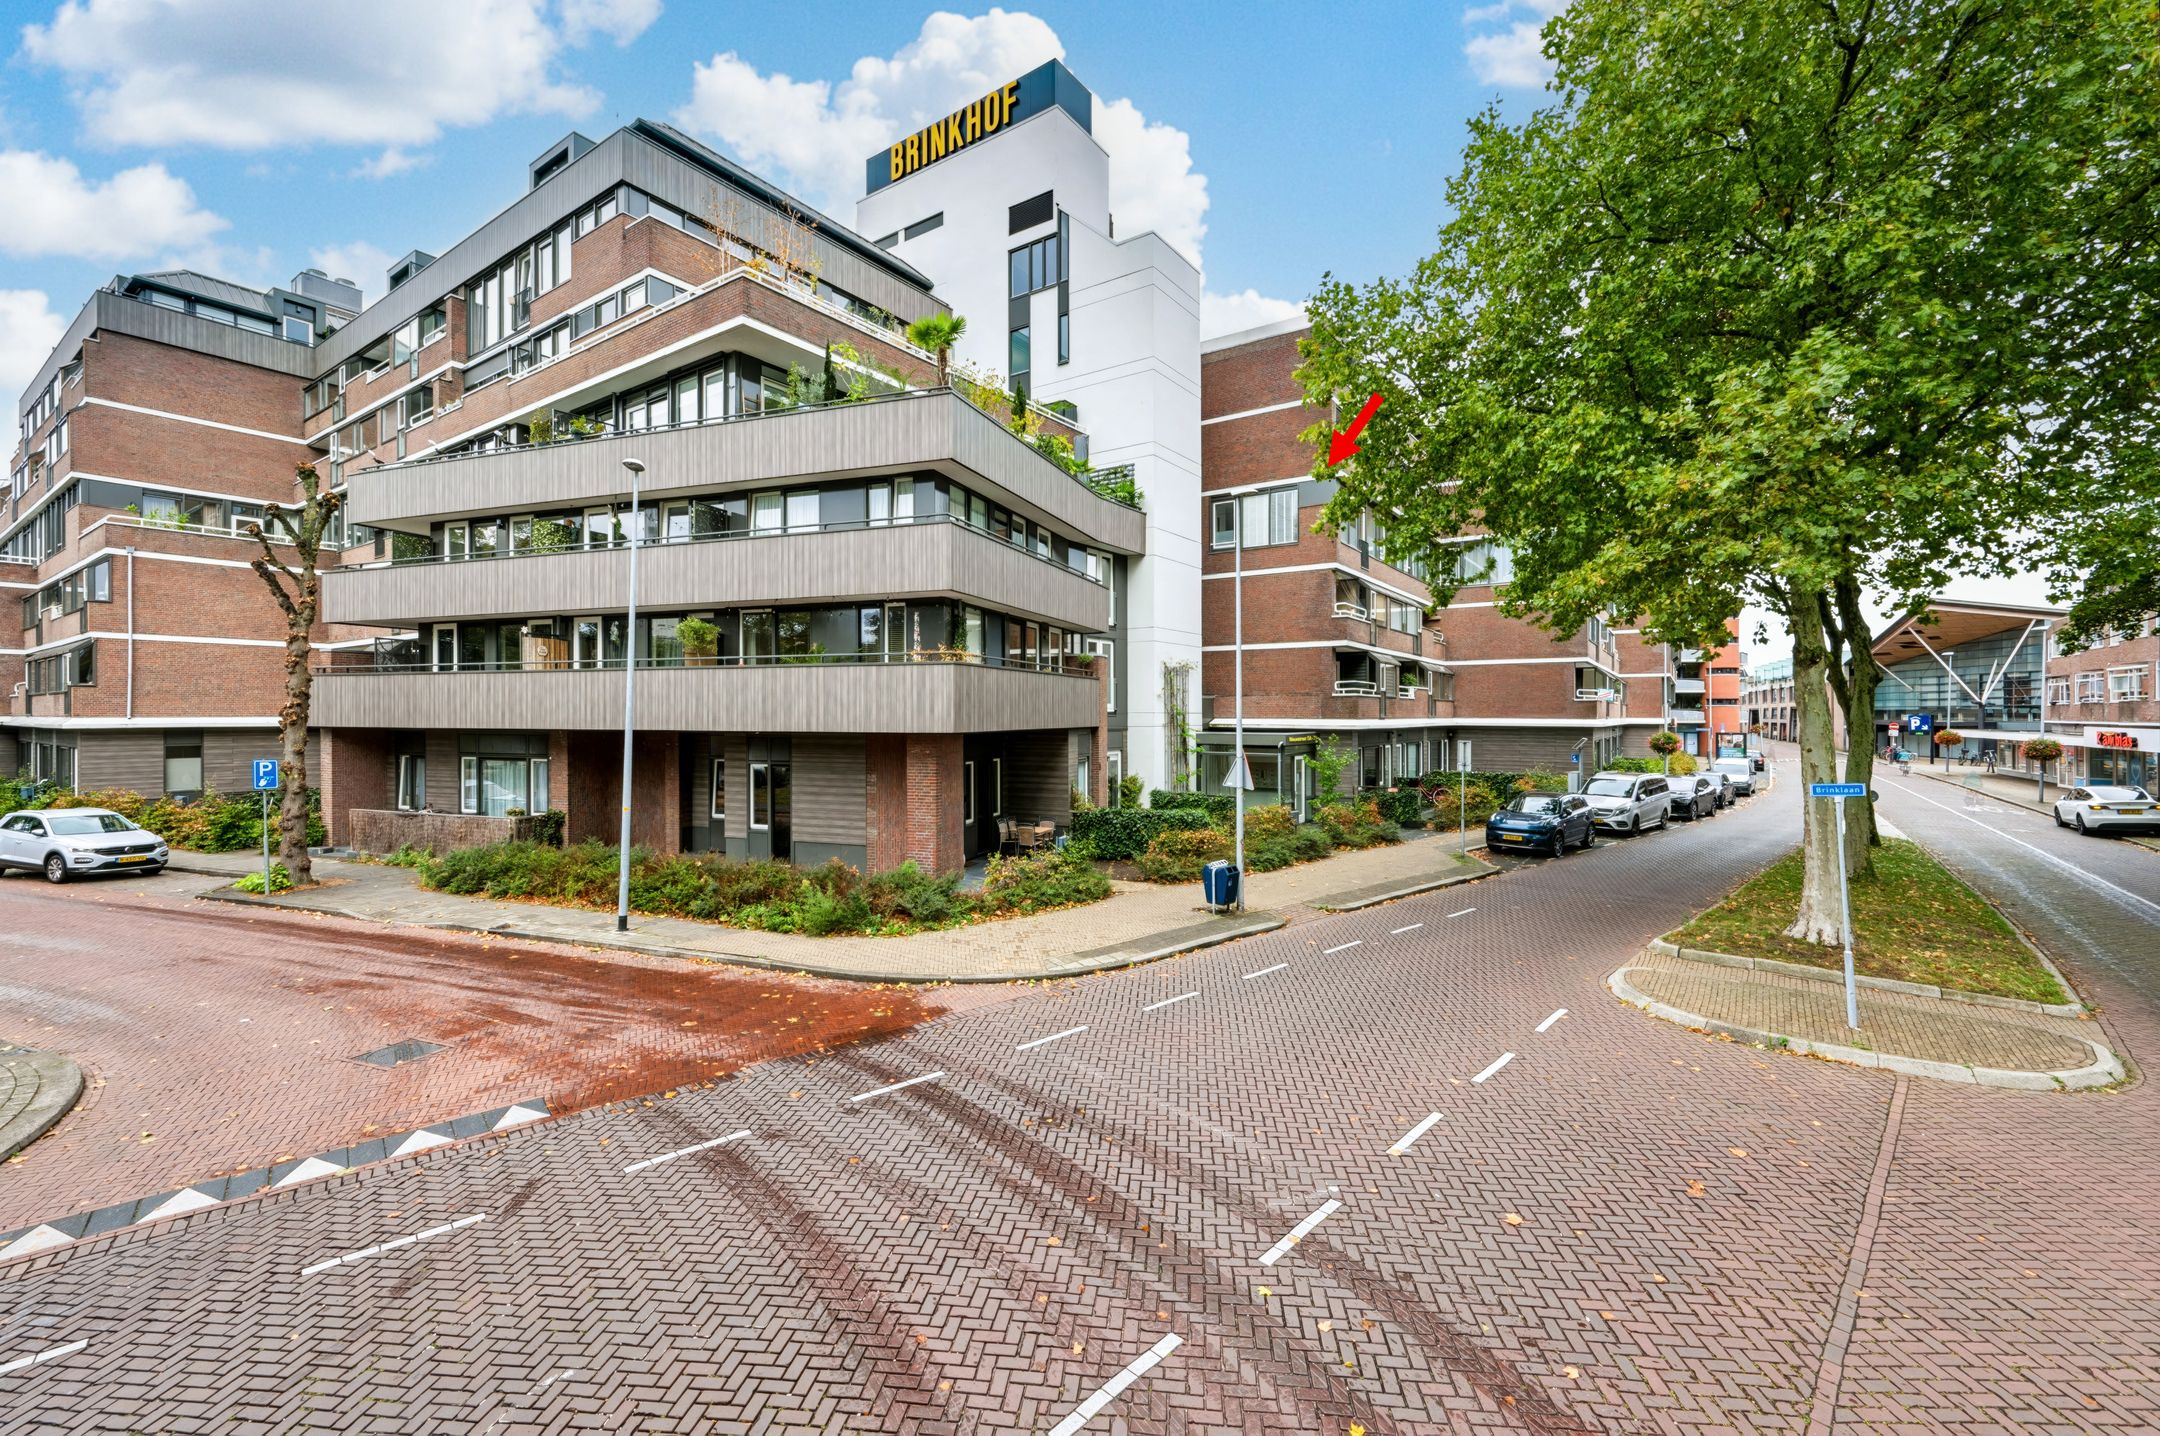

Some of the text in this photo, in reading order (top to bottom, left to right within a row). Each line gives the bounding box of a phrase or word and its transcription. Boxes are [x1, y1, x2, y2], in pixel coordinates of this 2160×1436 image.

[890, 80, 1018, 181] BRINKHOF
[1911, 719, 1921, 730] P
[259, 762, 273, 777] P
